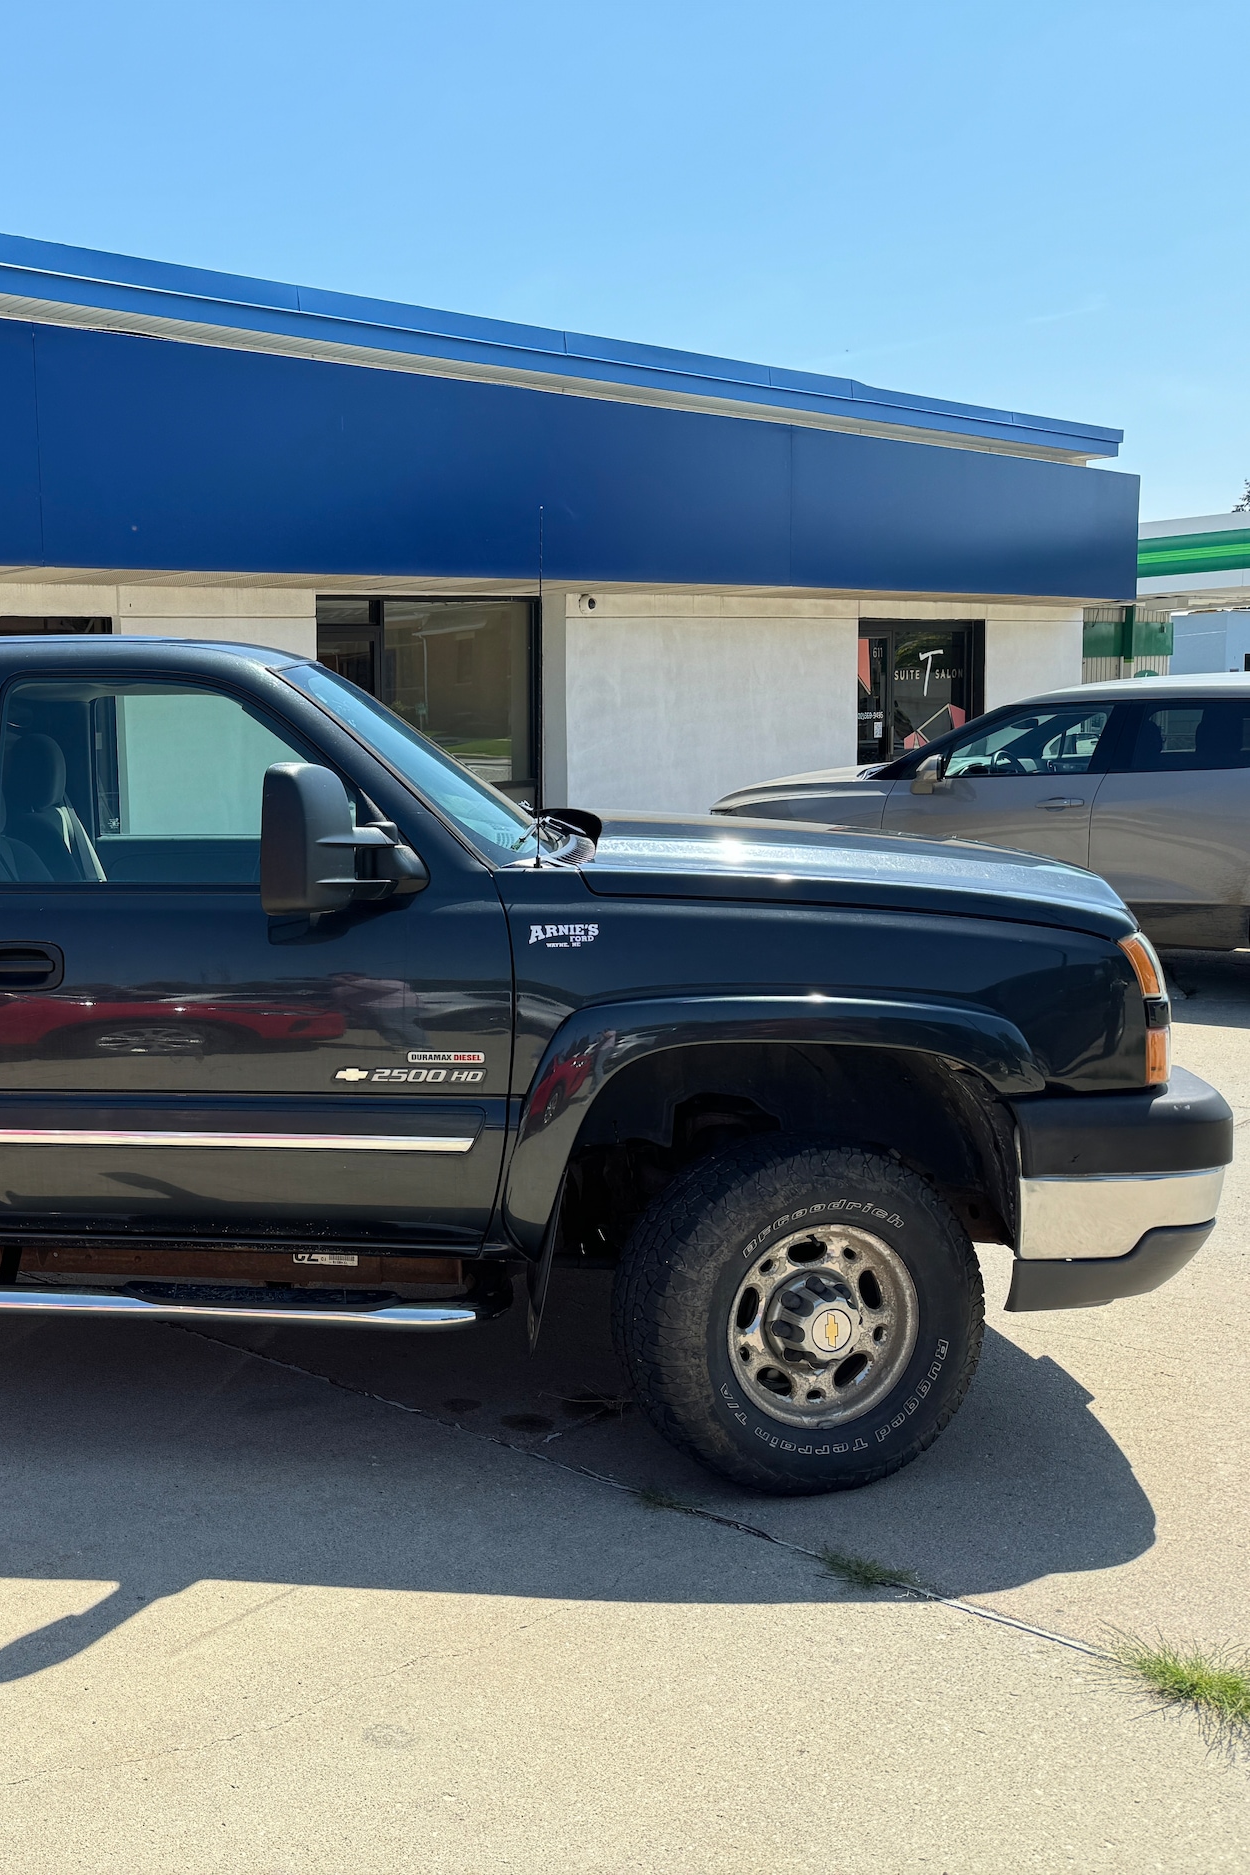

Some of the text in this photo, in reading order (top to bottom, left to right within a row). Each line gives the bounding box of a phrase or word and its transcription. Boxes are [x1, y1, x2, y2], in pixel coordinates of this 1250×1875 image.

[872, 647, 884, 659] 611
[894, 649, 964, 697] SUITE T SALON
[529, 923, 600, 945] ARNIE'S
[569, 935, 595, 943] FORD
[371, 1069, 484, 1083] 2500 HD
[742, 1198, 905, 1259] BFGoodrich
[718, 1337, 949, 1456] Rugged Terrain T/A
